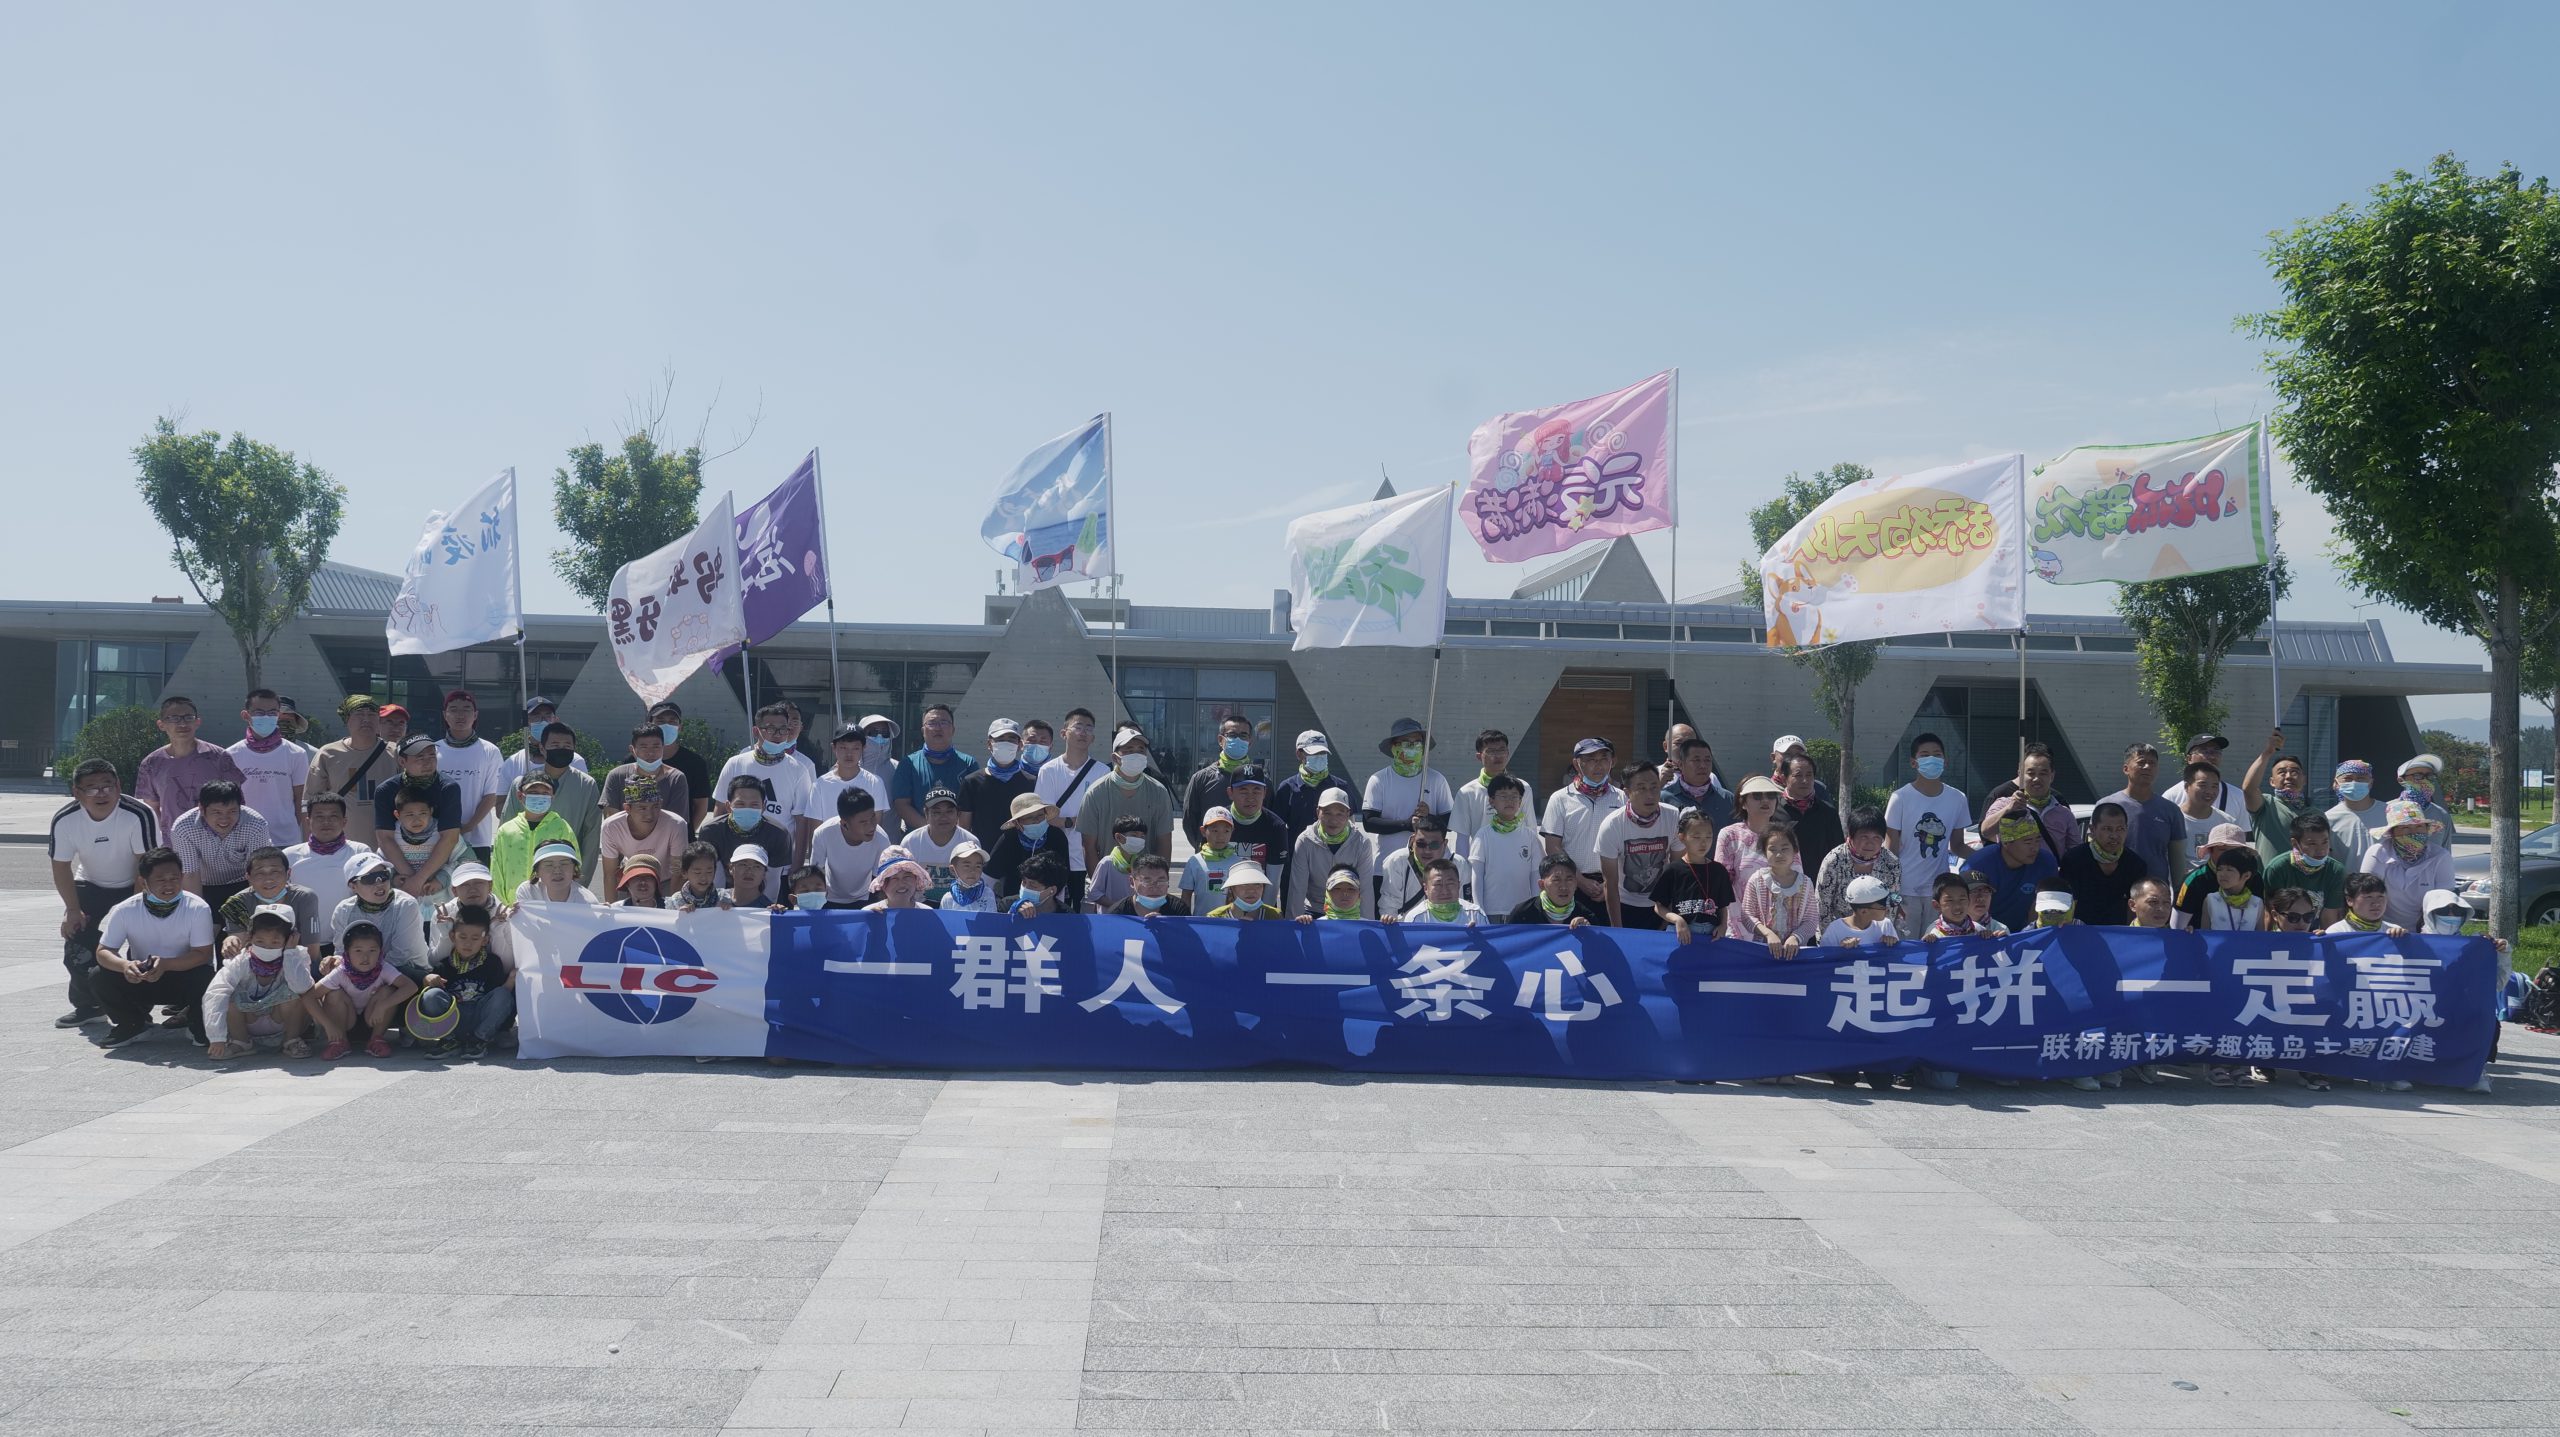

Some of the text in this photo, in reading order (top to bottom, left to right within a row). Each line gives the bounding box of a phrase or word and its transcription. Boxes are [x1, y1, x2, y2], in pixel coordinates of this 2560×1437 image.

[560, 966, 719, 993] LIC
[824, 936, 2444, 1032] 一群人 一条心 一起拼 一定赢
